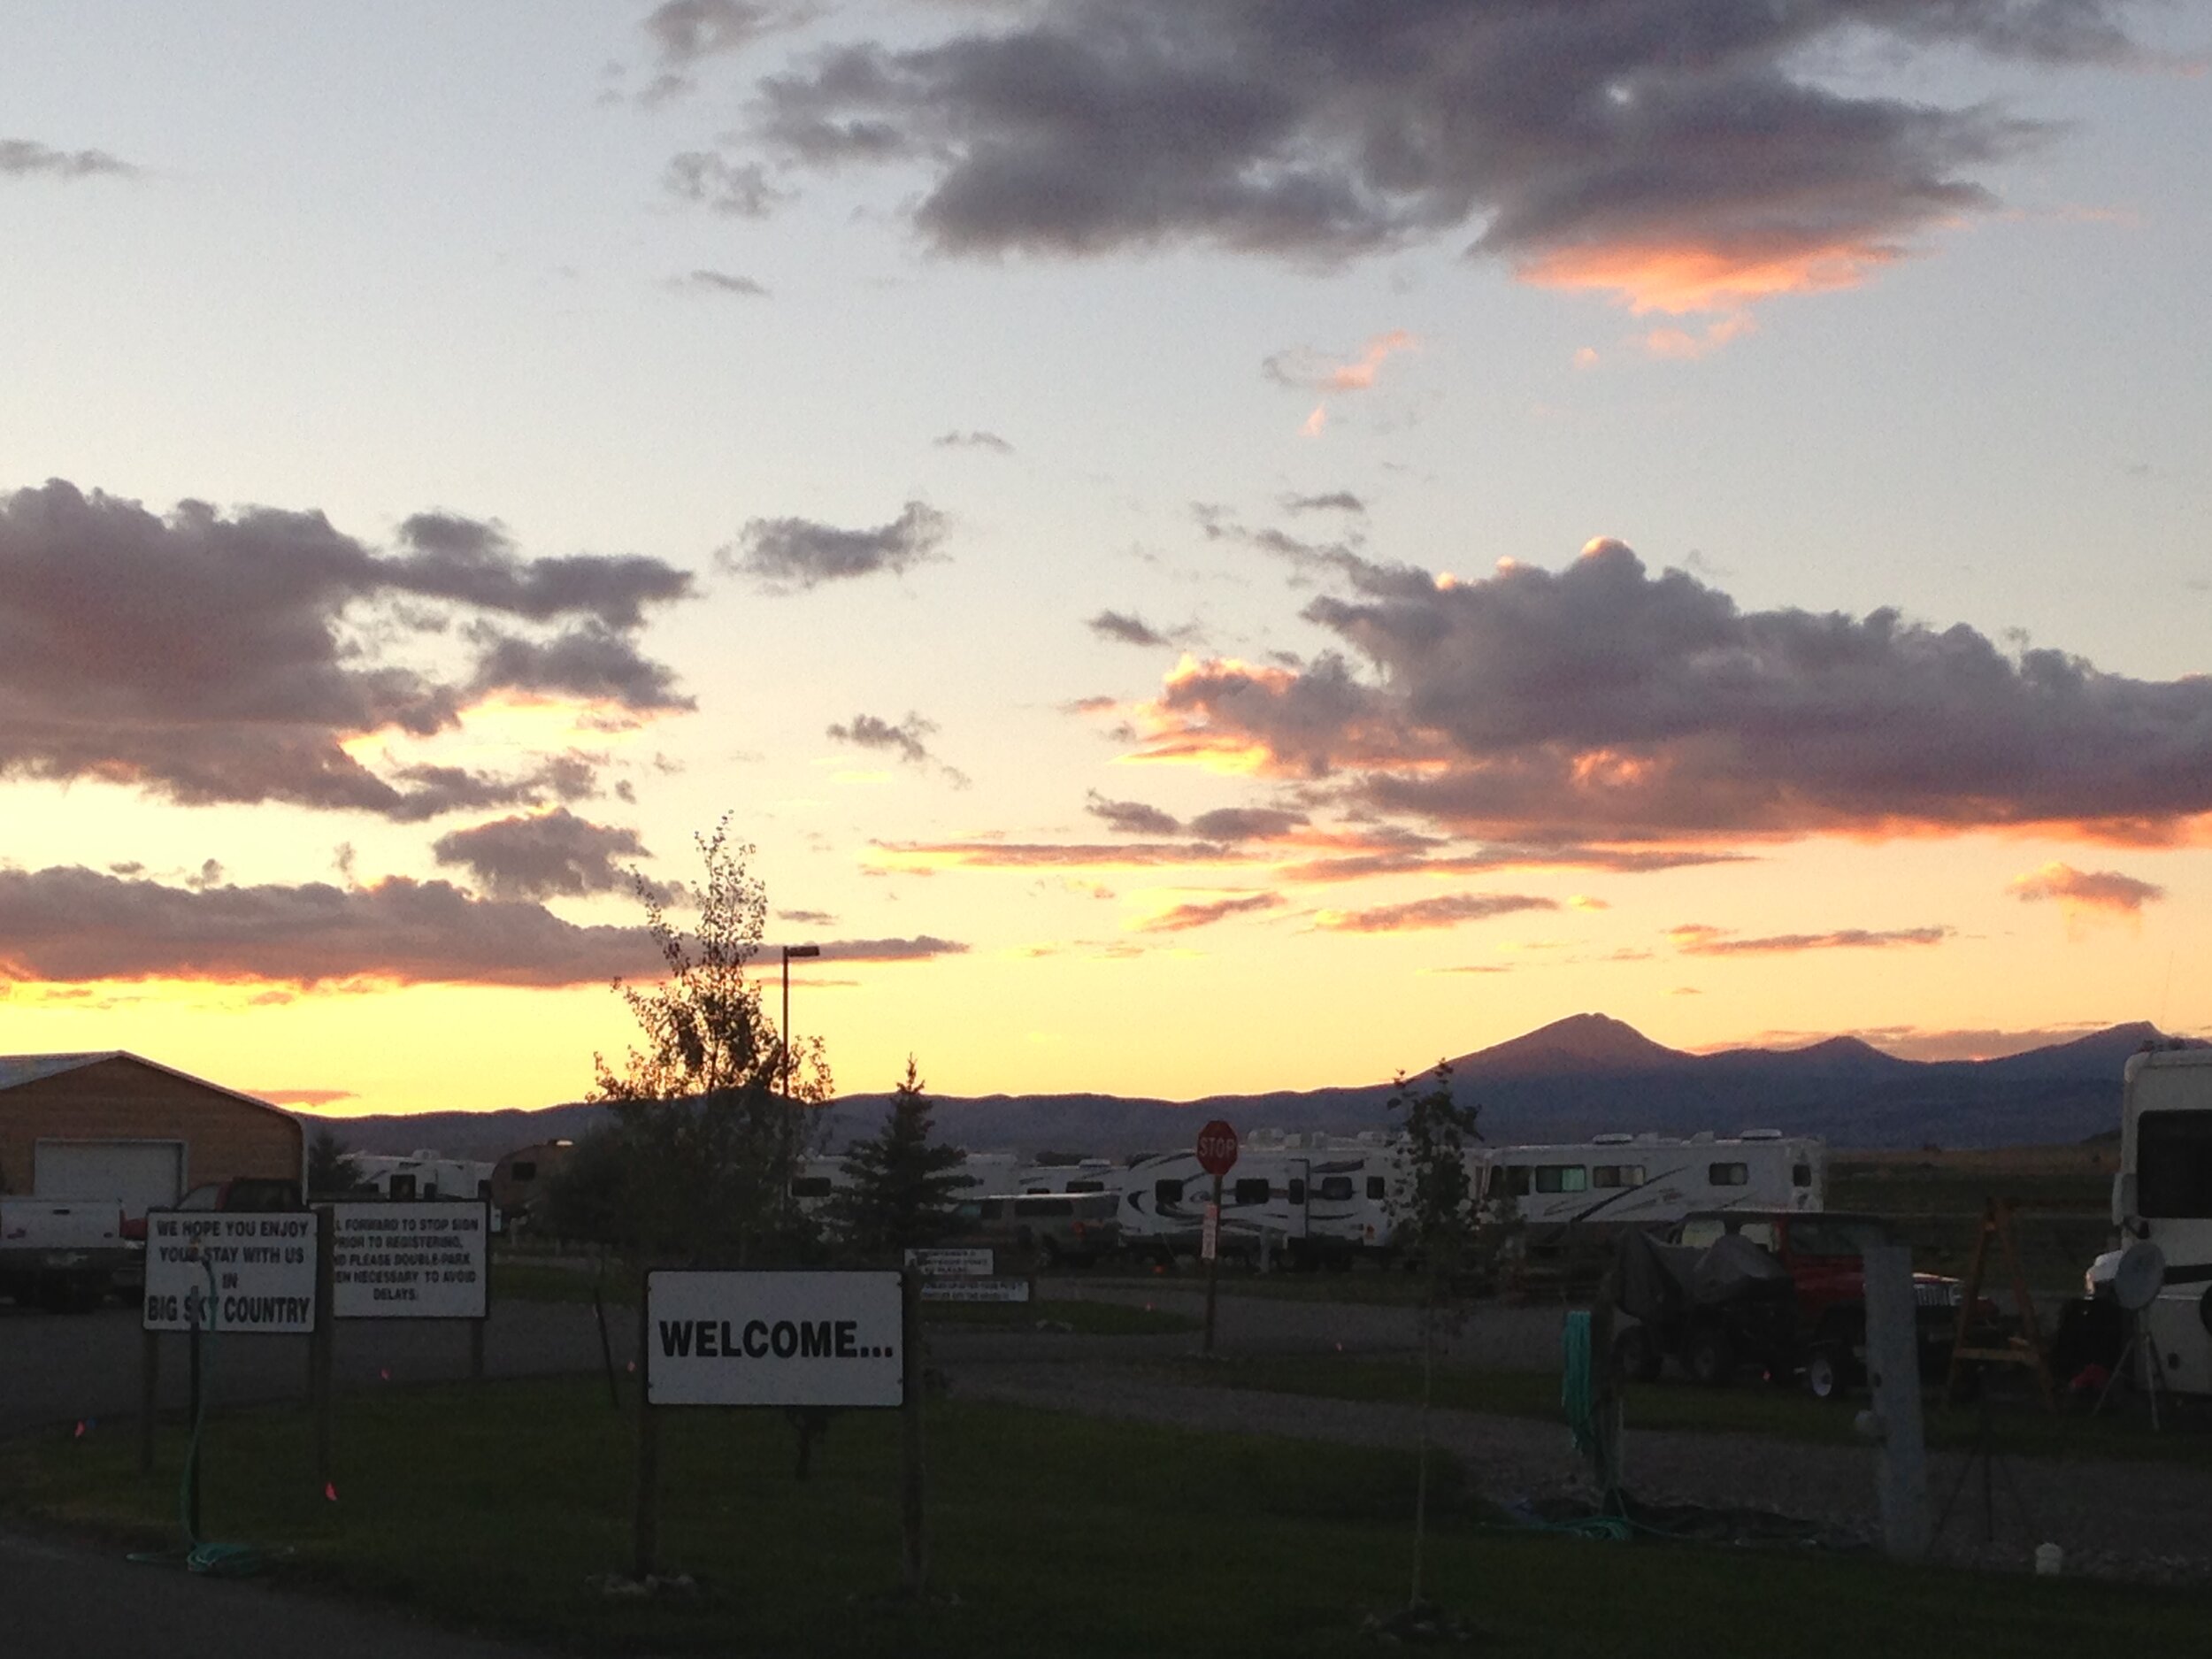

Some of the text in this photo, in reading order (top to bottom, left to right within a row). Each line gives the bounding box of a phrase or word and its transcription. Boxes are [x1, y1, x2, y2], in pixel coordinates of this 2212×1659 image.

[1199, 1136, 1236, 1159] STOP
[157, 1221, 309, 1237] WE HOPE YOU ENJOY
[345, 1218, 399, 1231] FORWARD
[403, 1218, 416, 1231] TO
[419, 1218, 449, 1231] STOP
[452, 1218, 479, 1231] SIGN
[368, 1236, 382, 1248] TO
[204, 1247, 239, 1263] STAY
[243, 1247, 280, 1263] WITH
[285, 1247, 304, 1263] US
[349, 1254, 391, 1265] PLEASE
[222, 1272, 238, 1288] IN
[354, 1271, 419, 1283] NECESSARY
[425, 1271, 439, 1283] TO
[442, 1271, 476, 1283] AVOID
[148, 1295, 177, 1321] BIG
[224, 1296, 311, 1324] COUNTRY
[659, 1320, 894, 1359] WELCOME...
